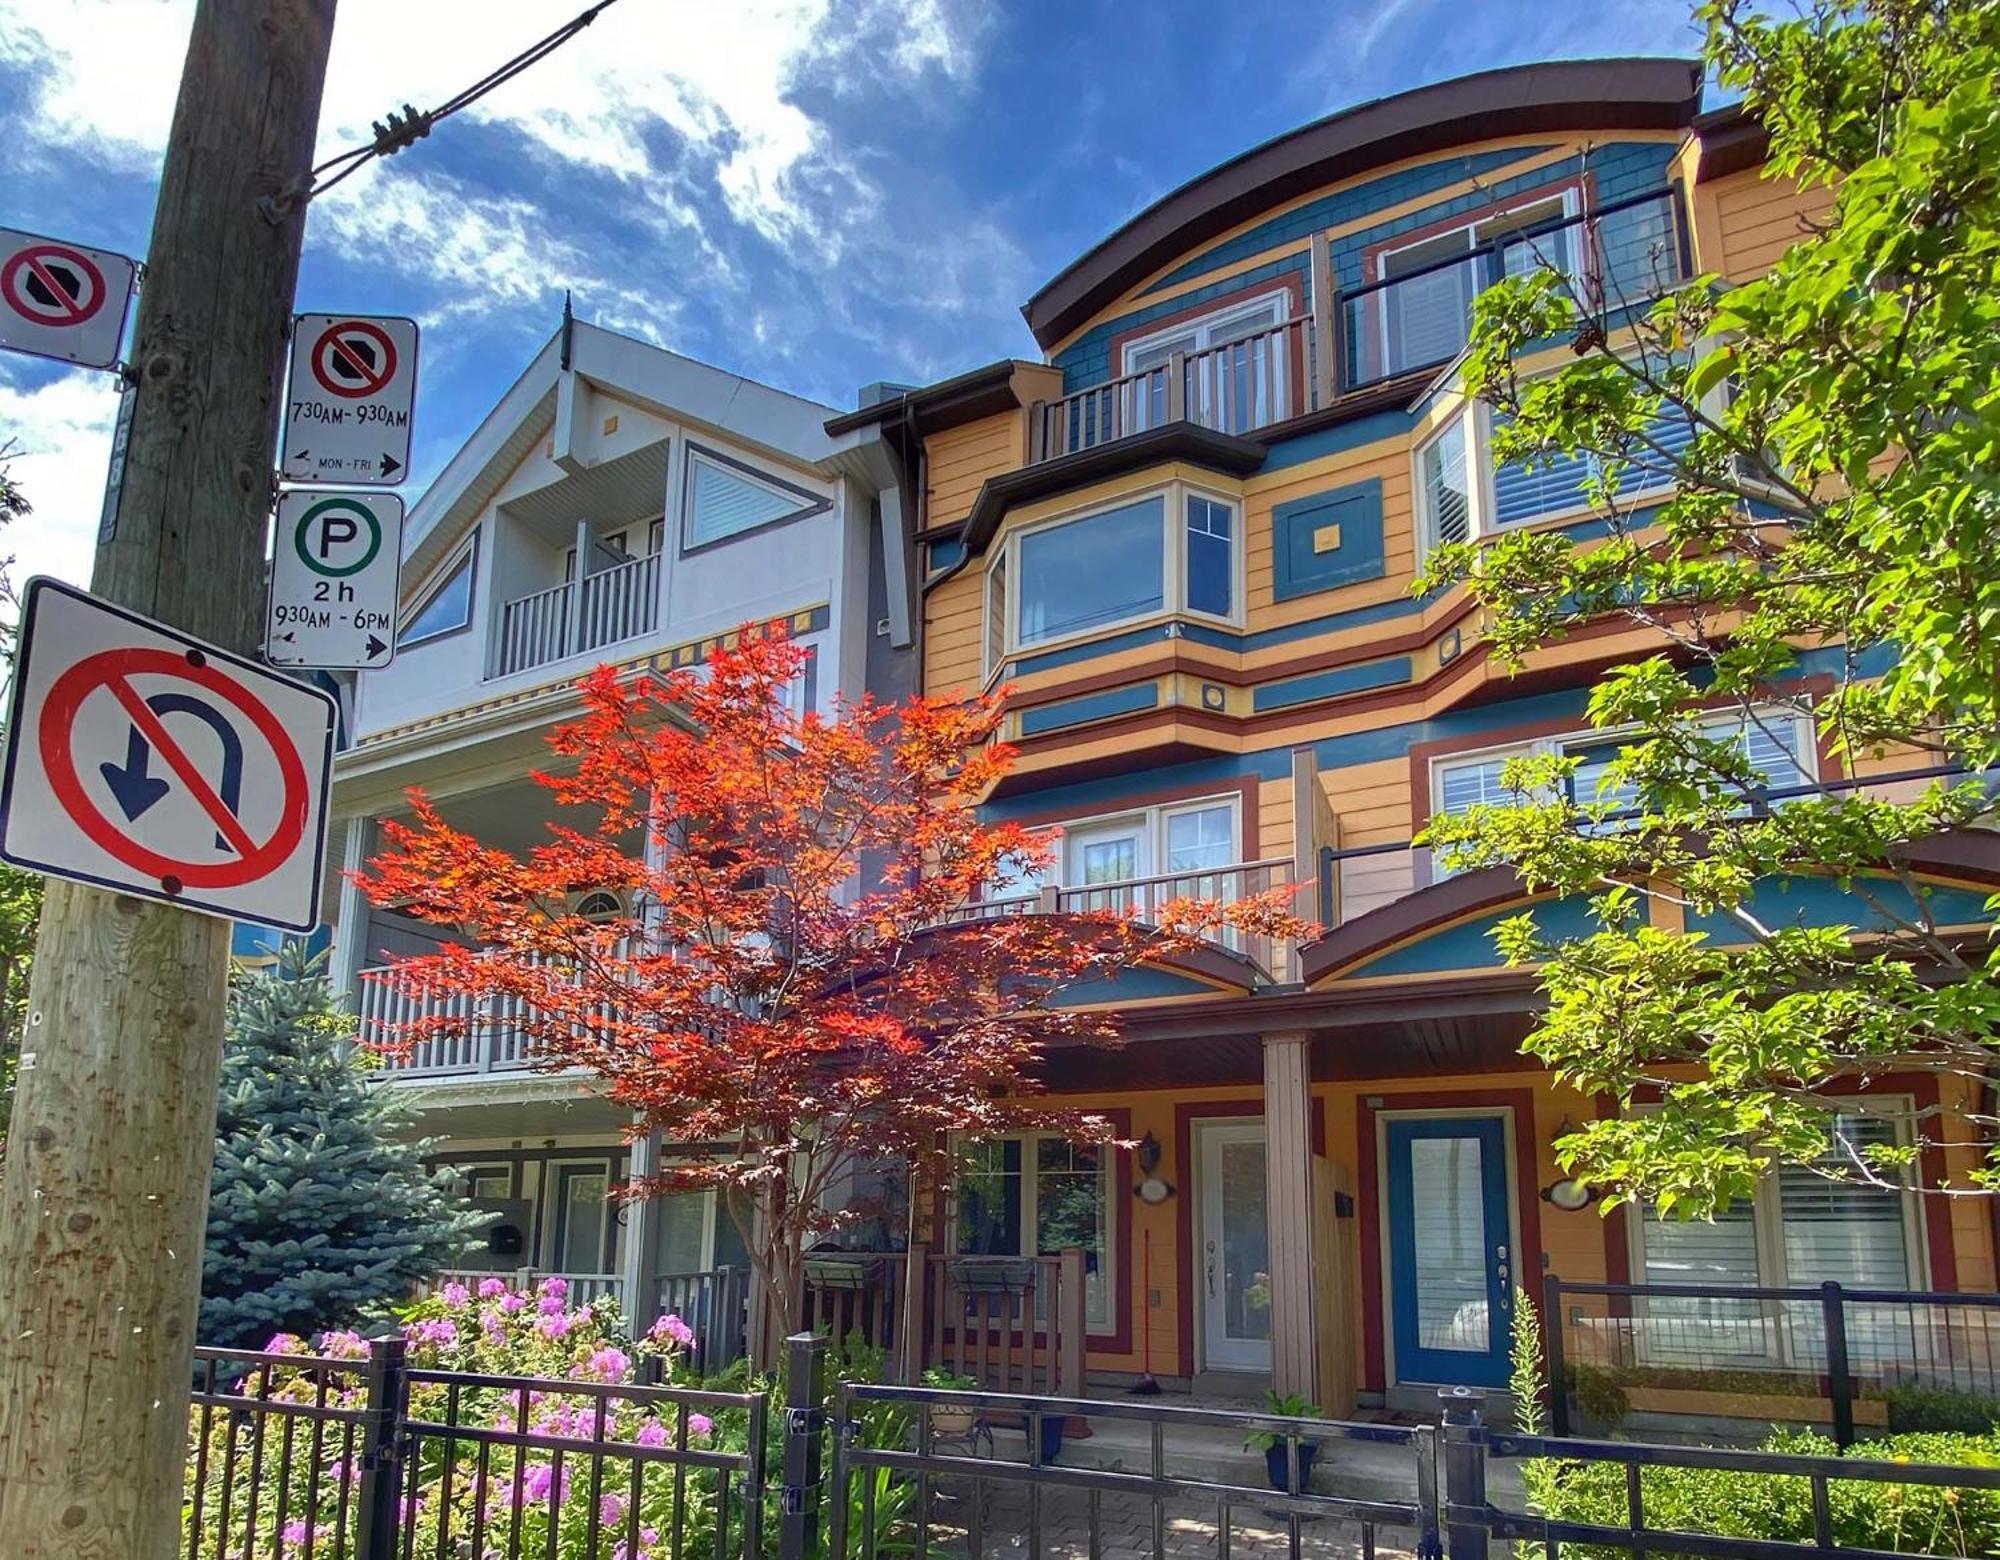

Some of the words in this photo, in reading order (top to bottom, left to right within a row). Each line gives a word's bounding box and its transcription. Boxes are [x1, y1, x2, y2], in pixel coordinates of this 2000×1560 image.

[318, 458, 343, 470] MON
[353, 459, 372, 470] FRI
[320, 517, 358, 558] P
[275, 605, 331, 628] 930AM
[353, 608, 390, 630] 6PM
